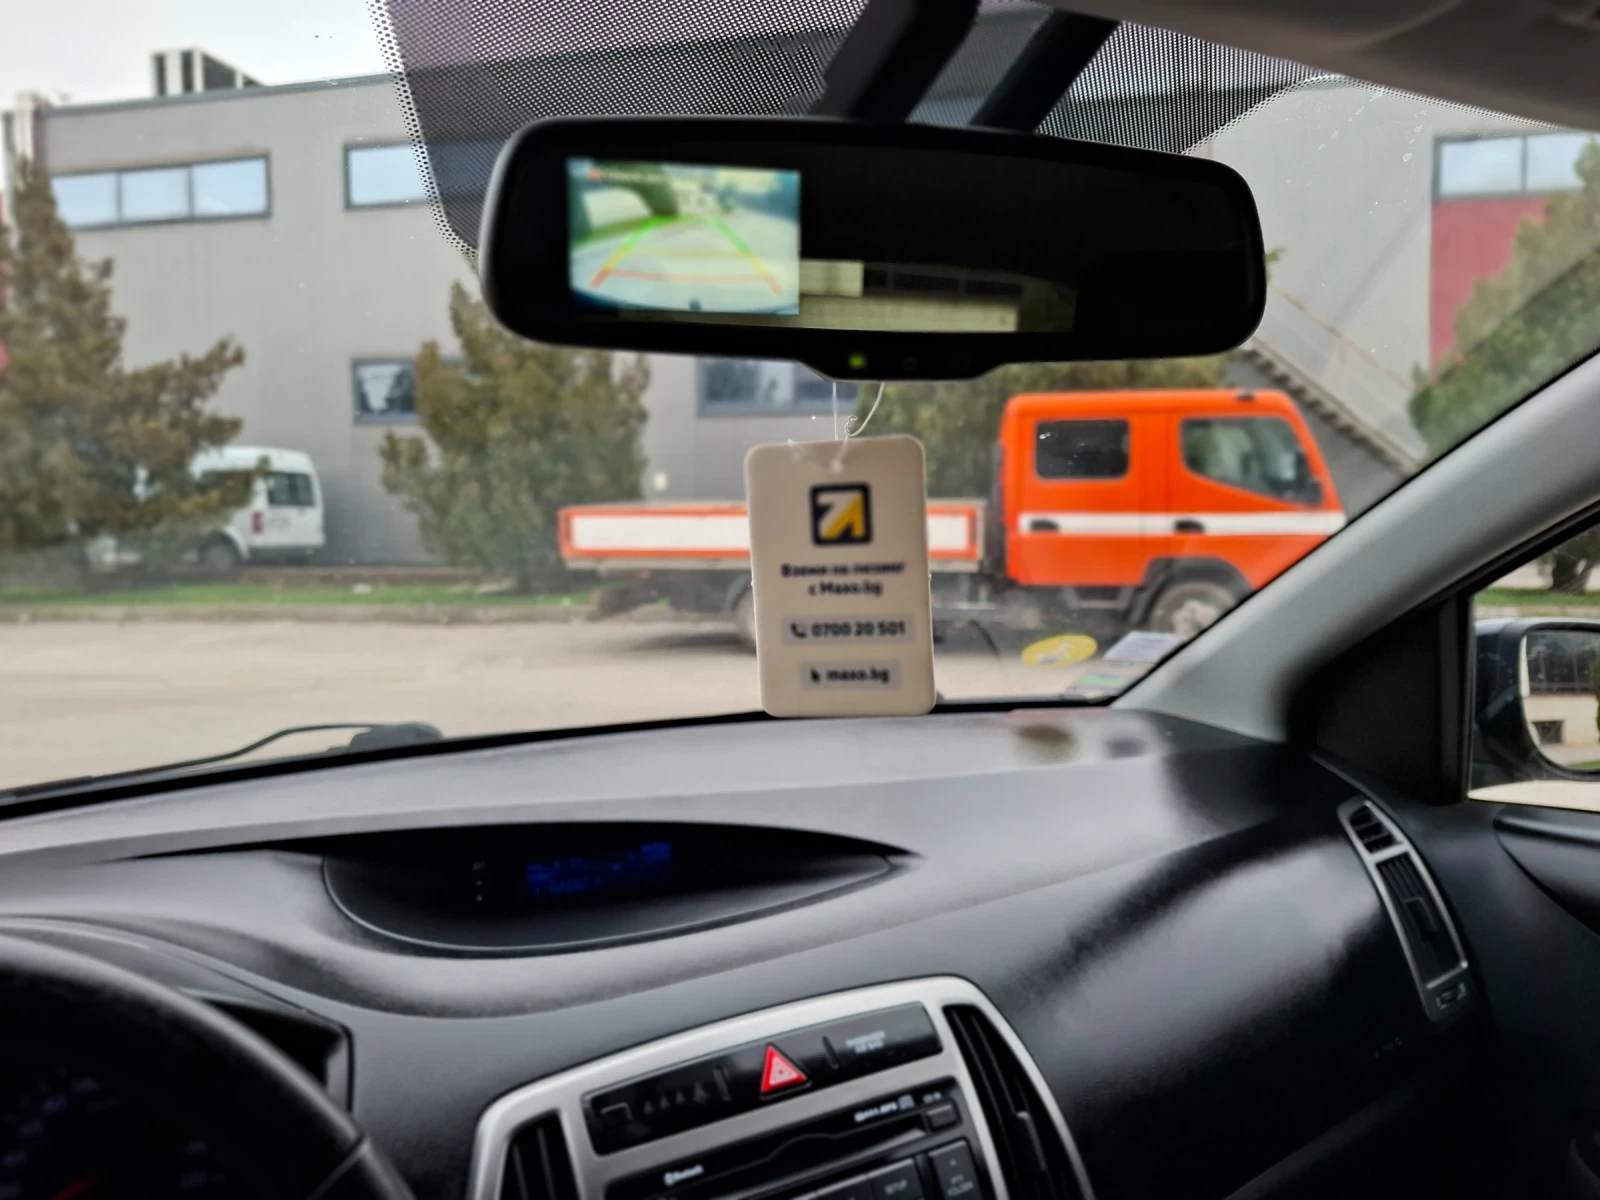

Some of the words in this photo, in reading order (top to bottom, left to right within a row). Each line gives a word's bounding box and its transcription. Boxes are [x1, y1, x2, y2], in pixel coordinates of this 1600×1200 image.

[811, 621, 852, 637] 0700
[854, 621, 875, 637] 20
[877, 620, 906, 636] 501
